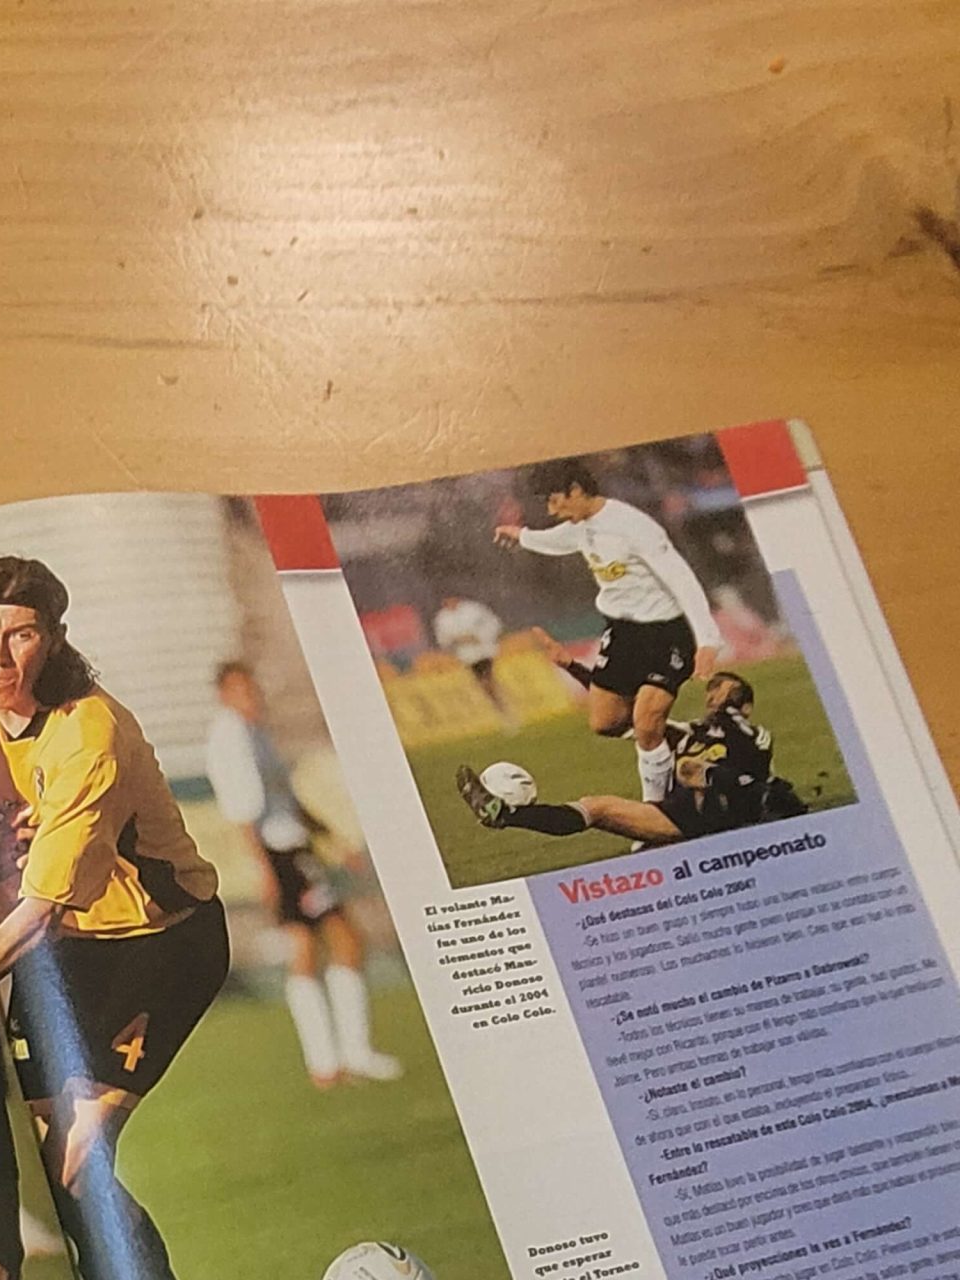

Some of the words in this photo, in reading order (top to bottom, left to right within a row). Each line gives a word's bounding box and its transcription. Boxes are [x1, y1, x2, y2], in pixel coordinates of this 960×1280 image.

[559, 866, 664, 904] Vistazo
[673, 860, 692, 880] al
[697, 831, 827, 875] campeonato
[424, 905, 438, 916] El
[440, 899, 487, 914] volante
[489, 894, 515, 905] Ma-
[426, 922, 451, 933] tías
[452, 910, 521, 929] Fernández
[436, 938, 457, 949] fue
[459, 934, 485, 944] uno
[488, 930, 504, 940] de
[505, 926, 527, 936] los
[438, 947, 505, 965] elementos
[507, 942, 532, 955] que
[451, 963, 502, 980] destacó
[503, 959, 537, 971] Mau-
[461, 983, 492, 996] ricio
[493, 974, 543, 990] Donoso
[450, 999, 501, 1015] durante
[504, 994, 517, 1005] el
[518, 988, 549, 1003] 2004
[472, 1019, 489, 1029] en
[490, 1012, 520, 1025] Colo
[522, 1006, 556, 1019] Colo.
[112, 1012, 149, 1072] 4
[527, 1240, 577, 1258] Donoso
[578, 1232, 609, 1245] tuvo
[534, 1263, 559, 1277] que
[561, 1249, 612, 1268] esperar
[592, 1261, 640, 1279] Torneo
